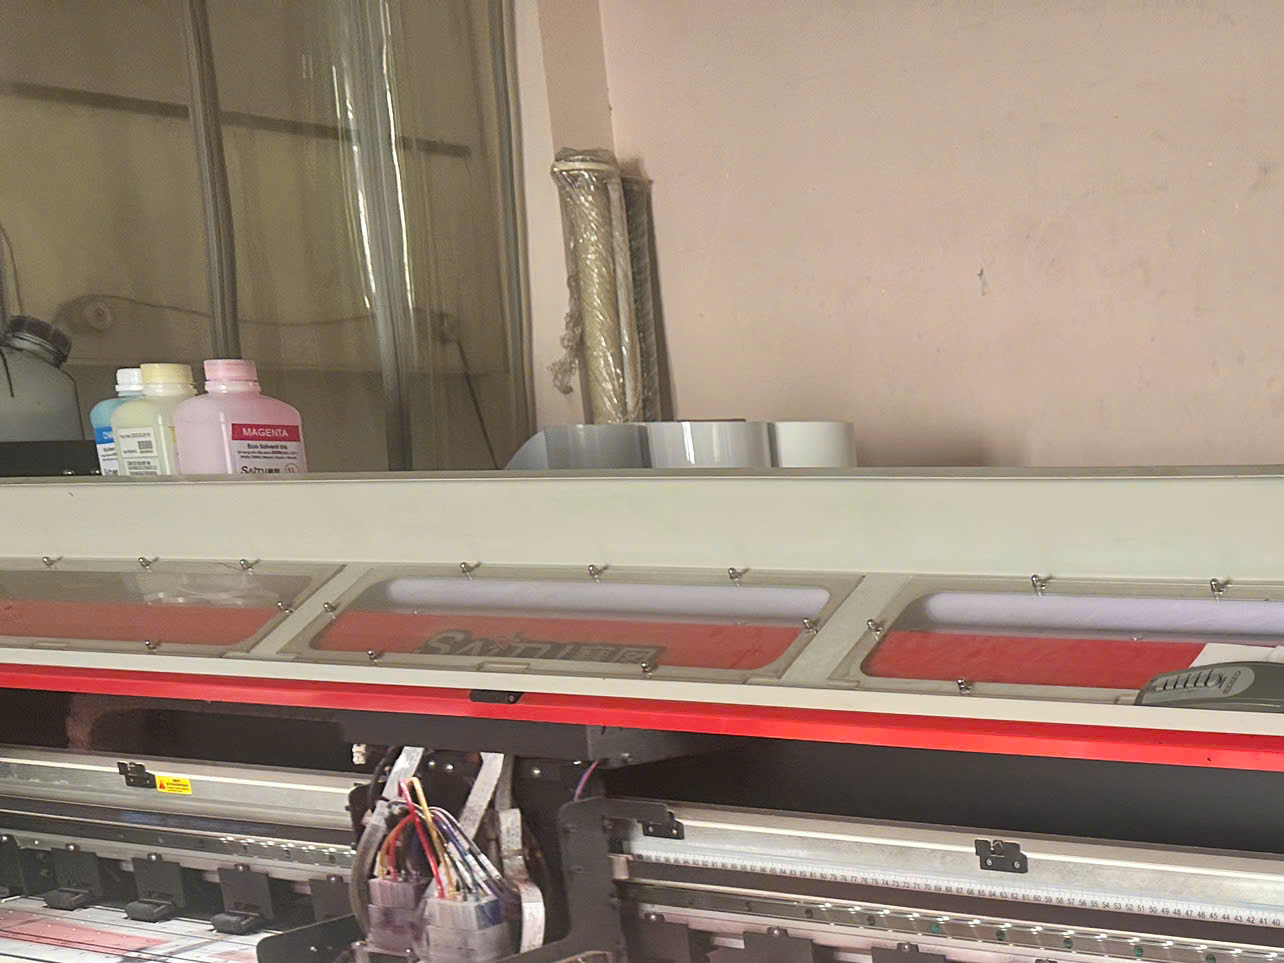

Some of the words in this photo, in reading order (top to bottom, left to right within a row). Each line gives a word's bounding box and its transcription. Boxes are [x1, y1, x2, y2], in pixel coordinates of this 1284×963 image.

[242, 427, 289, 438] MAGENTA
[1161, 907, 1169, 915] 49
[1172, 908, 1181, 916] 48
[1185, 909, 1193, 917] 47
[1234, 914, 1243, 922] 43
[1246, 916, 1255, 924] 42
[1259, 917, 1267, 925] 41
[1271, 918, 1280, 926] 40
